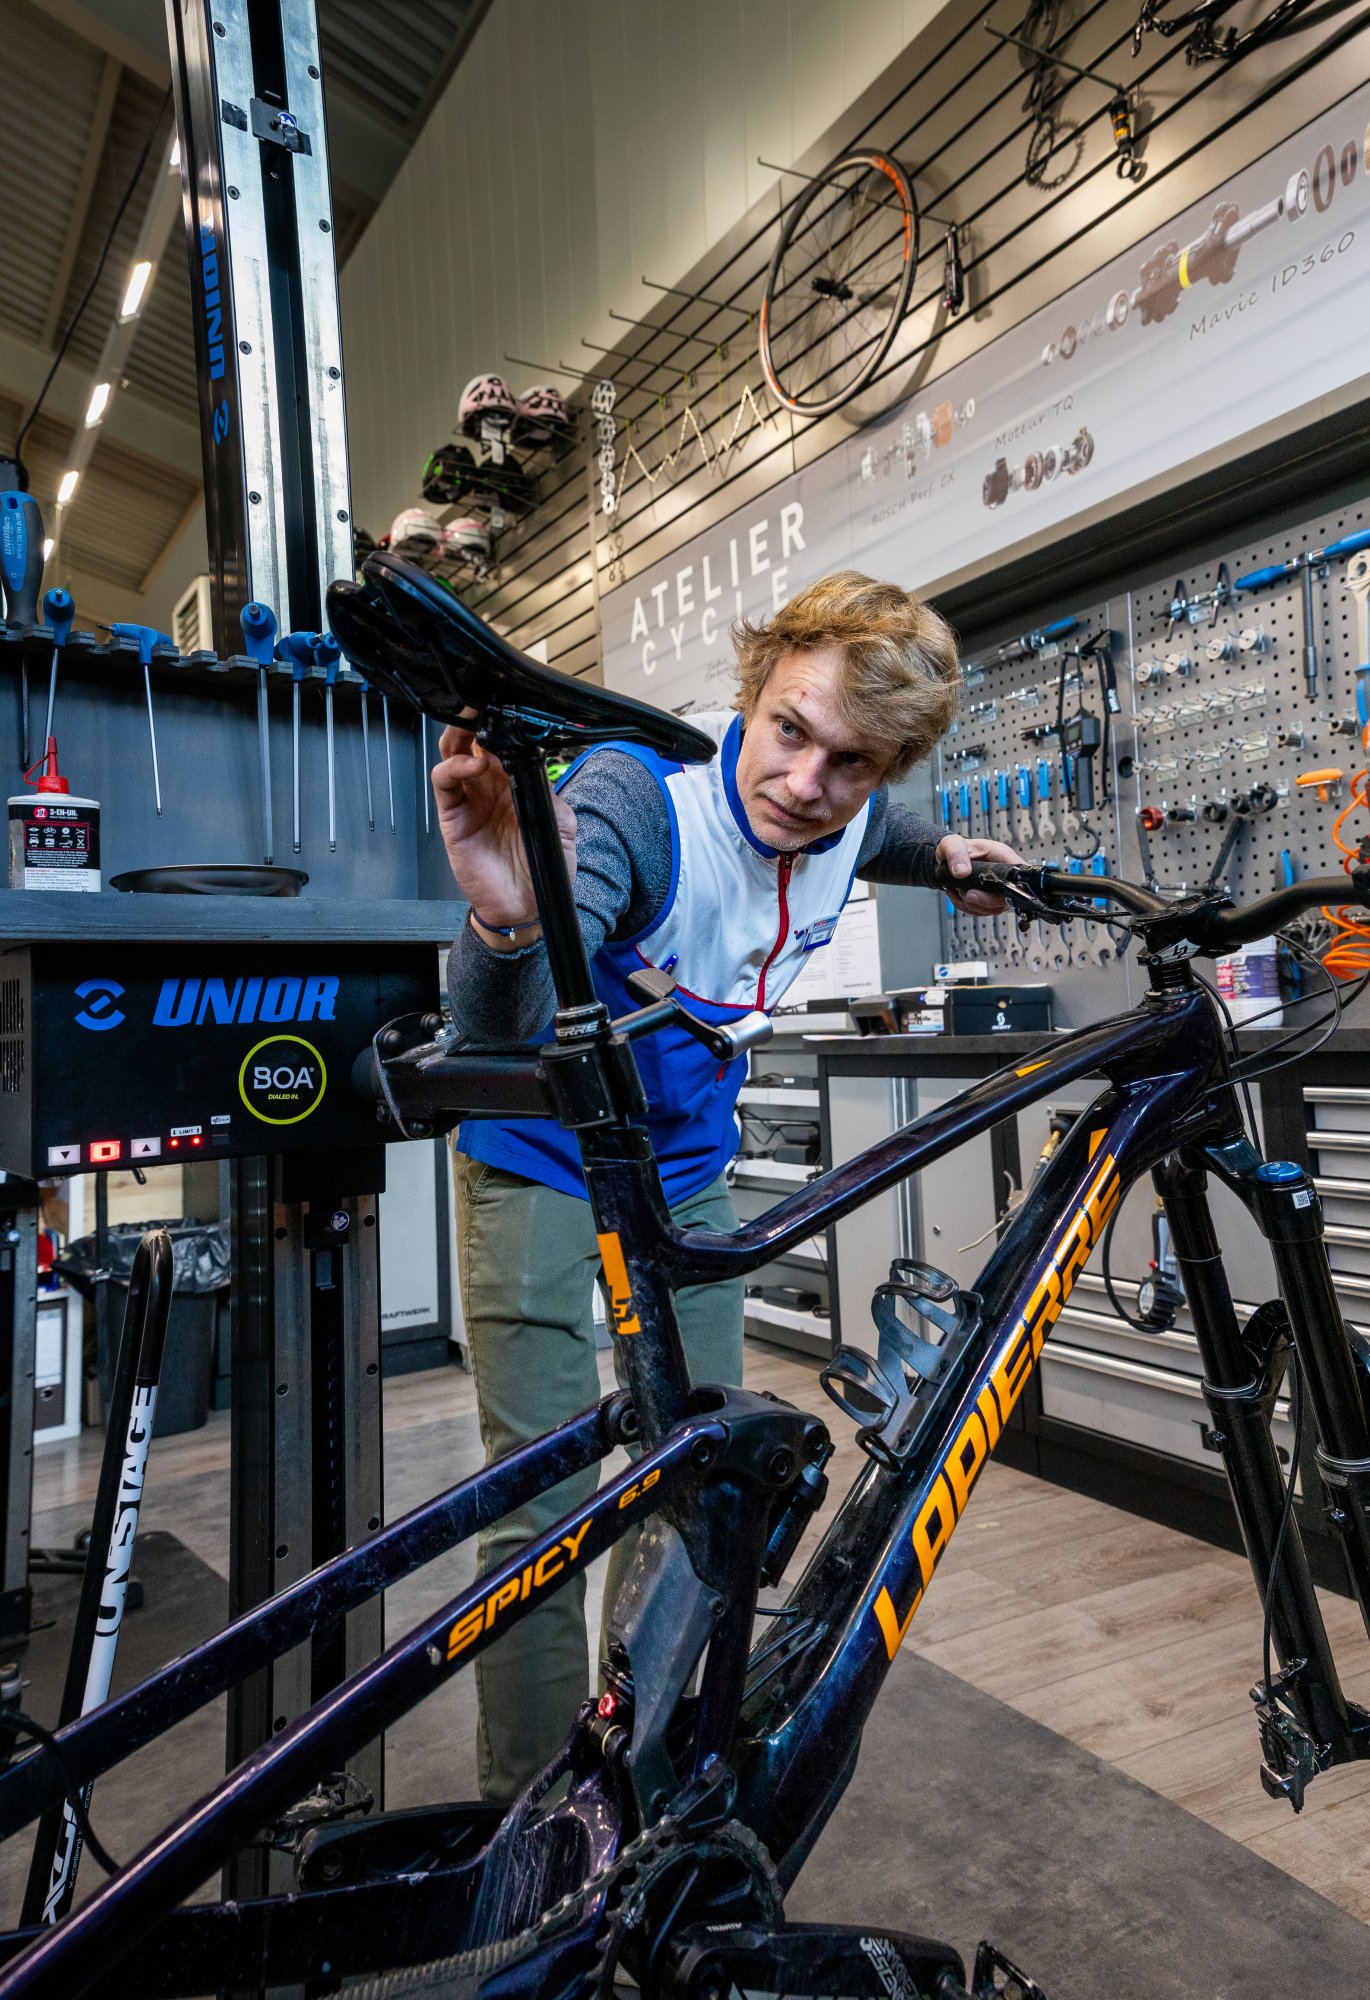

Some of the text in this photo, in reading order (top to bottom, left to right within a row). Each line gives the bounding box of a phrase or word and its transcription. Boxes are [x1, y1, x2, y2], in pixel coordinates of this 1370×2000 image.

[1189, 231, 1356, 341] Mavic ID360
[994, 395, 1075, 450] Moteur TQ
[630, 501, 807, 643] ATELIER
[152, 975, 340, 1027] UNIOR
[178, 1127, 195, 1136] LIMIT
[873, 1153, 1122, 1662] LAPIERRE
[618, 1468, 661, 1510] 6.9
[447, 1518, 593, 1662] SPICY
